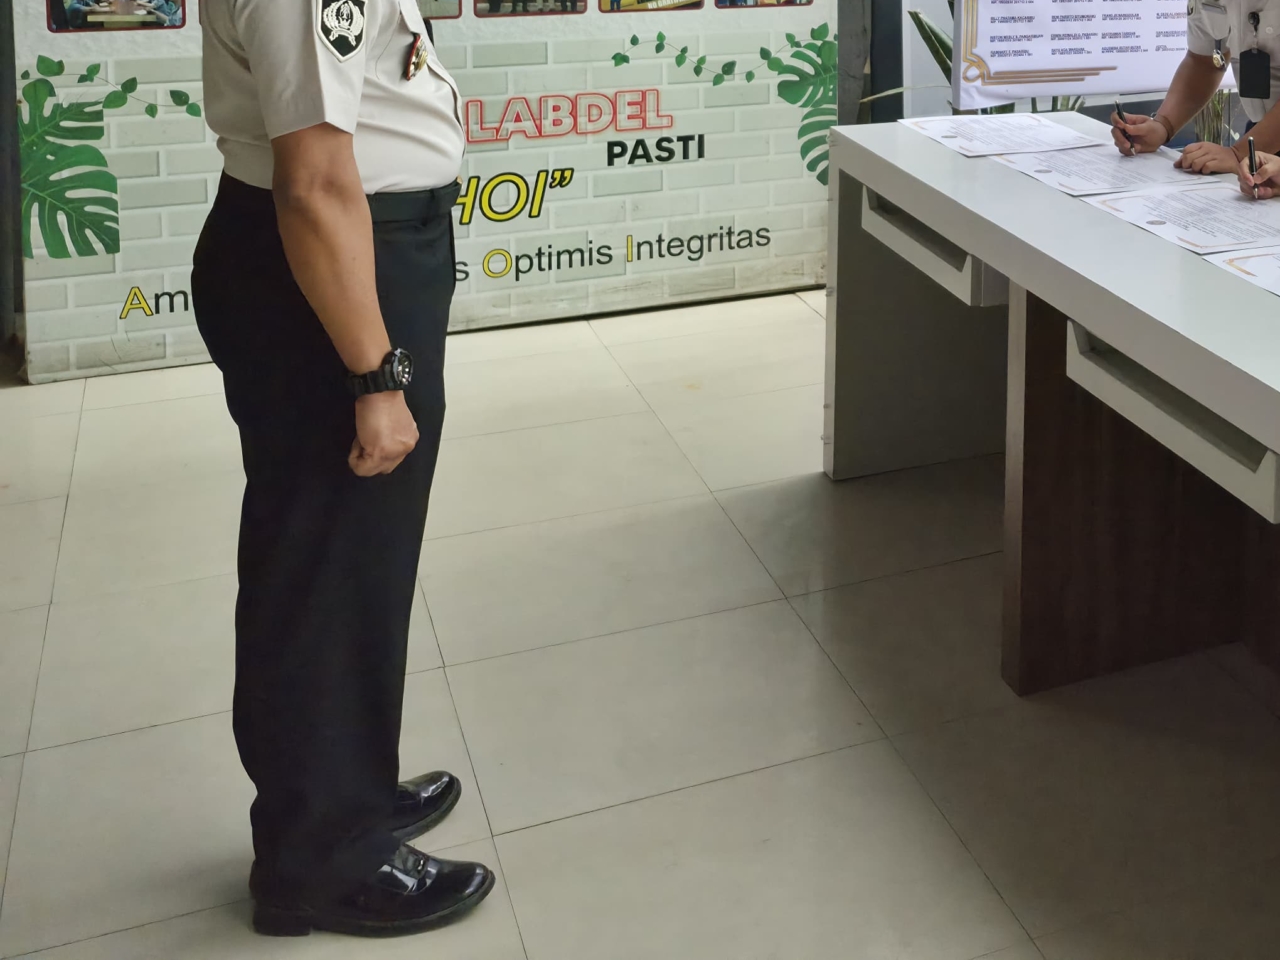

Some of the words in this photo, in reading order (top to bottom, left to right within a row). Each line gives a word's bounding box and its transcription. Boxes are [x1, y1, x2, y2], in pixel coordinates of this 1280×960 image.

[465, 88, 673, 143] LABDEL
[607, 134, 704, 166] PASTI
[482, 241, 613, 280] Optimis
[626, 228, 770, 262] Integritas
